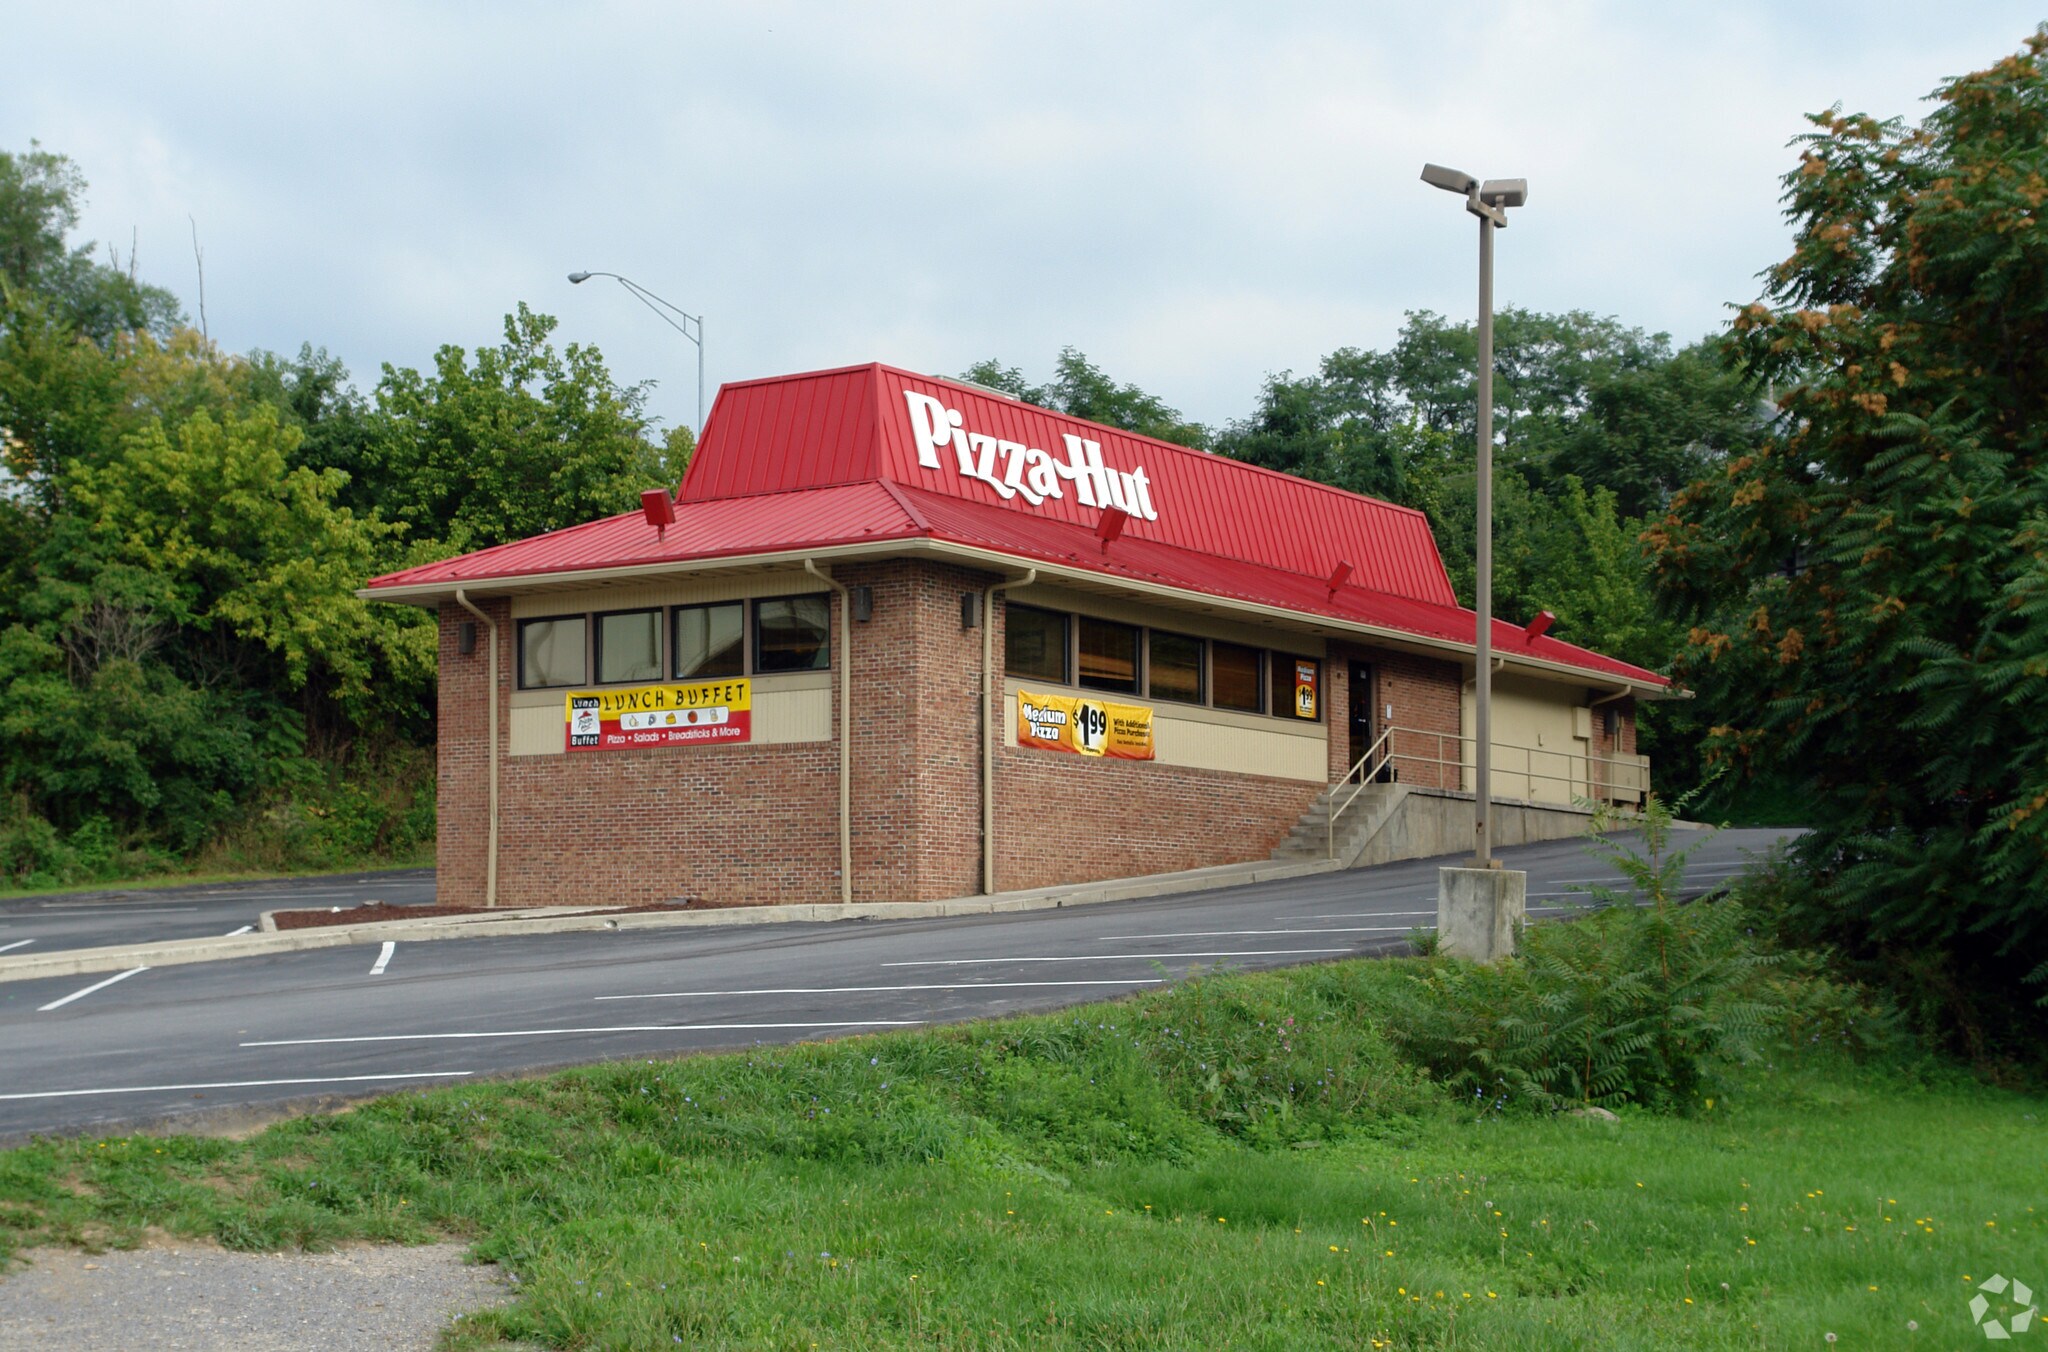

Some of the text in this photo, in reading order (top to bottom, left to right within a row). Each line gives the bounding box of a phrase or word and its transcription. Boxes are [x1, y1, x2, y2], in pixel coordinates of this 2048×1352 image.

[903, 389, 1158, 521] Pizza Hut
[573, 698, 599, 708] Lunch
[604, 684, 745, 711] LUNCH BUFFET
[1023, 703, 1067, 725] Medium
[607, 727, 741, 744] Pizza Salads Breadsticks & More
[1030, 721, 1060, 740] Pizza
[571, 735, 598, 746] Buffet
